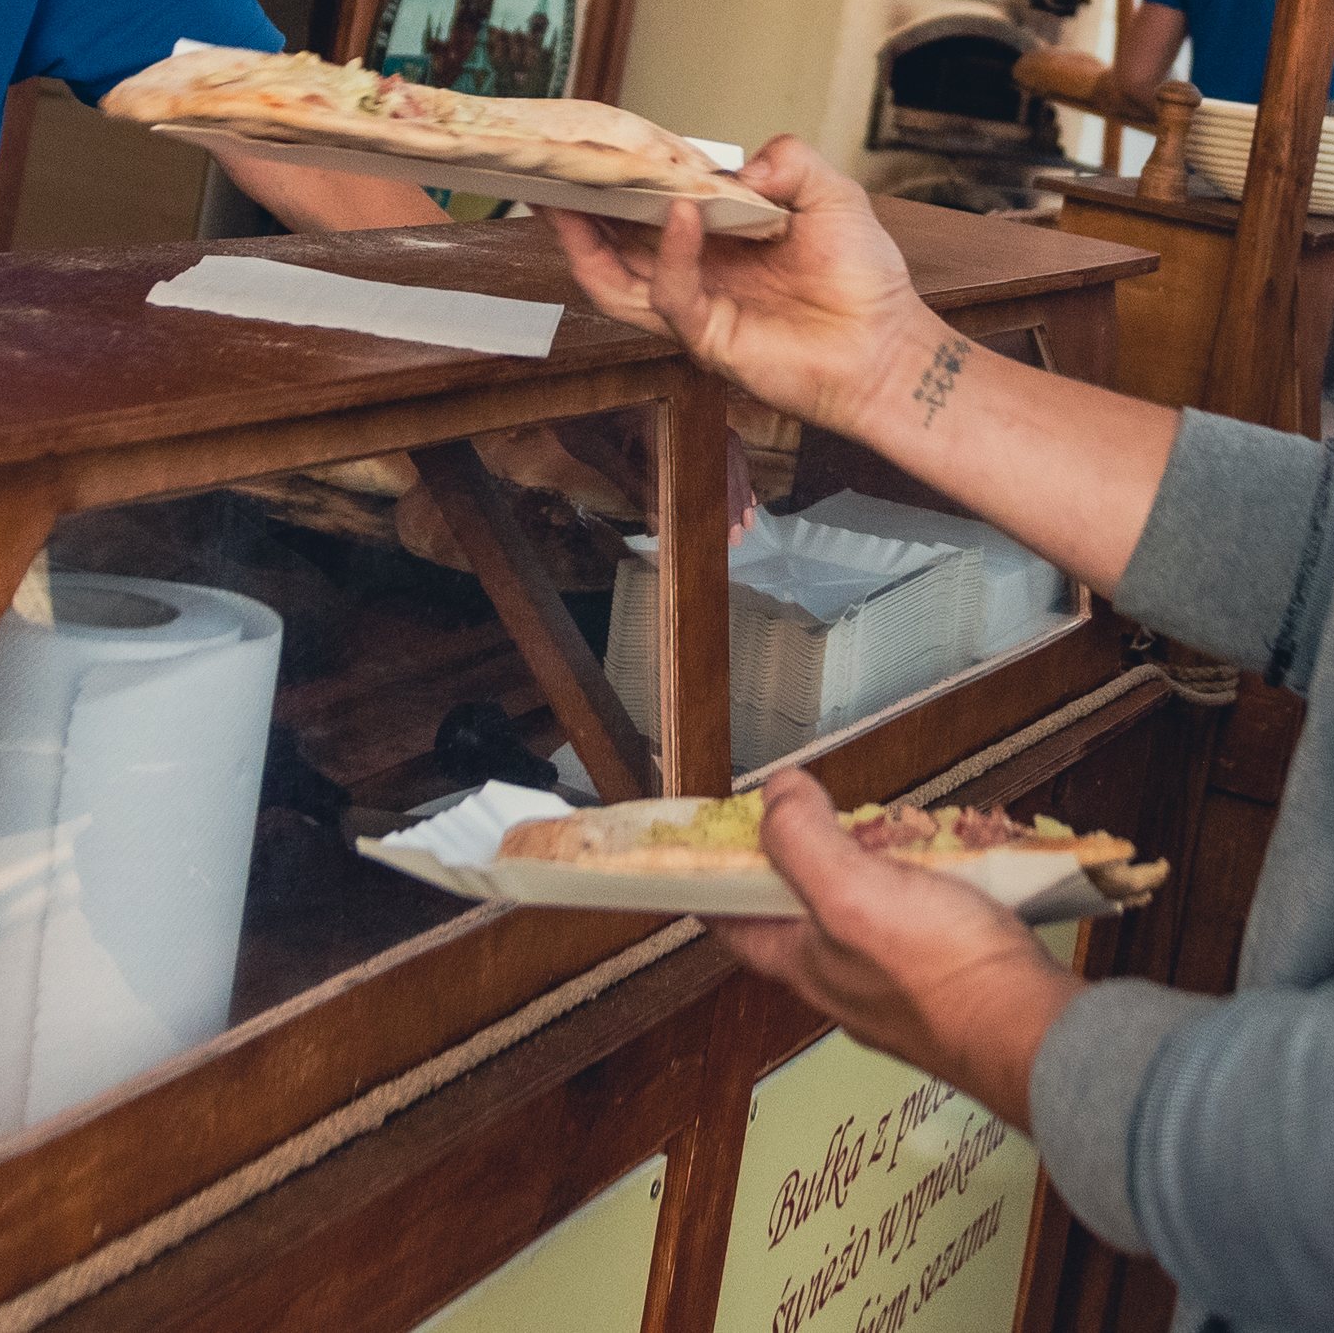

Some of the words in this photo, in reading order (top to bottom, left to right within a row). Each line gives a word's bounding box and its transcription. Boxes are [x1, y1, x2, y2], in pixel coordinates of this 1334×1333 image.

[768, 1115, 866, 1251] Bułka
[867, 1109, 893, 1168] z
[771, 1224, 870, 1333] świeżo
[913, 1195, 1005, 1311] sezamu
